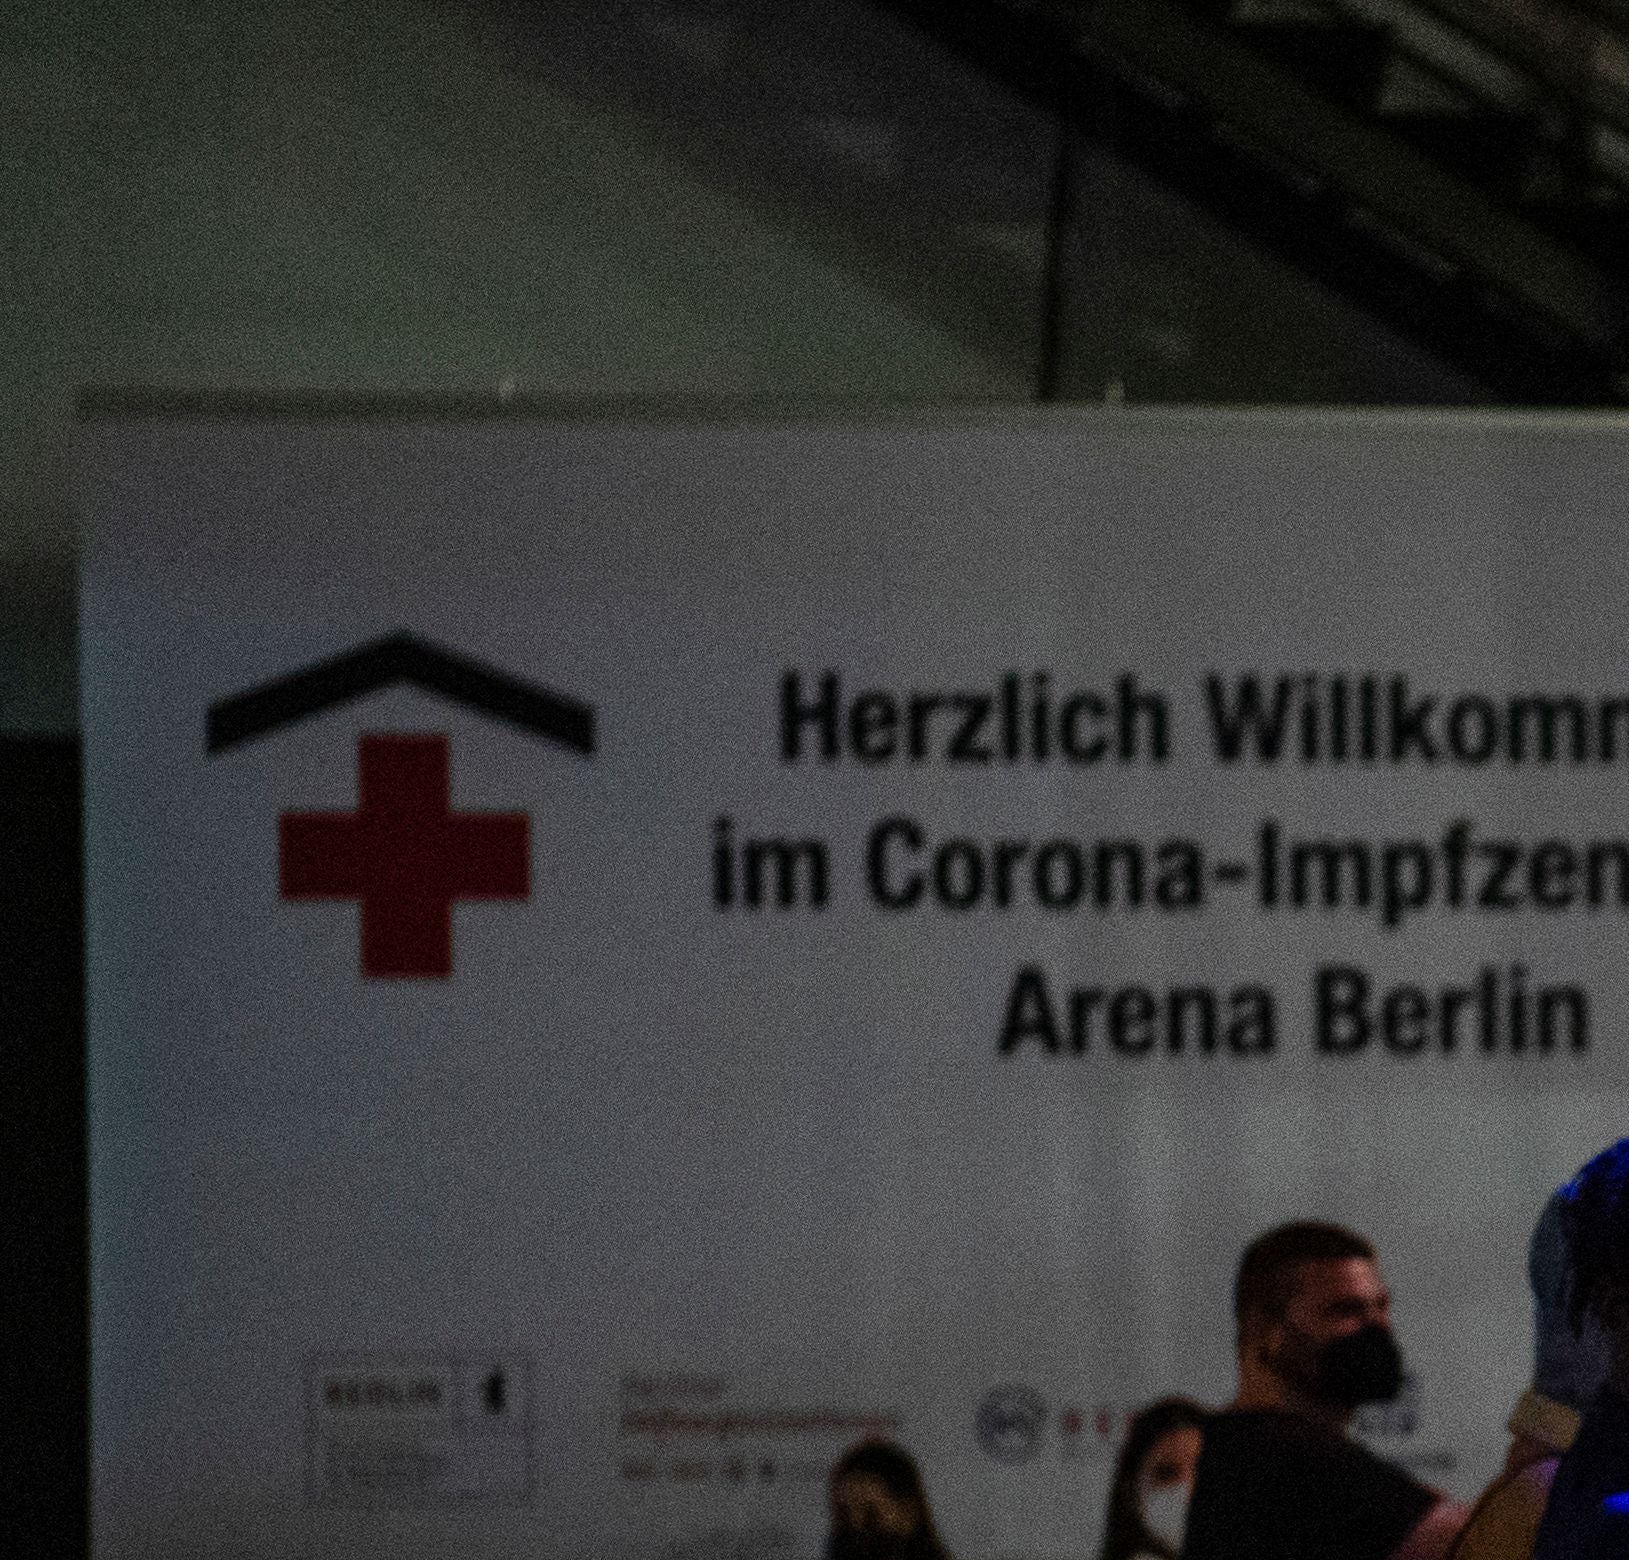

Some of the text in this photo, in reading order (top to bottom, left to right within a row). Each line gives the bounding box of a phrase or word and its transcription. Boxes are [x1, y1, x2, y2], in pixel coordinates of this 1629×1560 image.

[777, 669, 1172, 767] Herzlich
[710, 815, 832, 912] im
[995, 963, 1592, 1060] Arena Berlin
